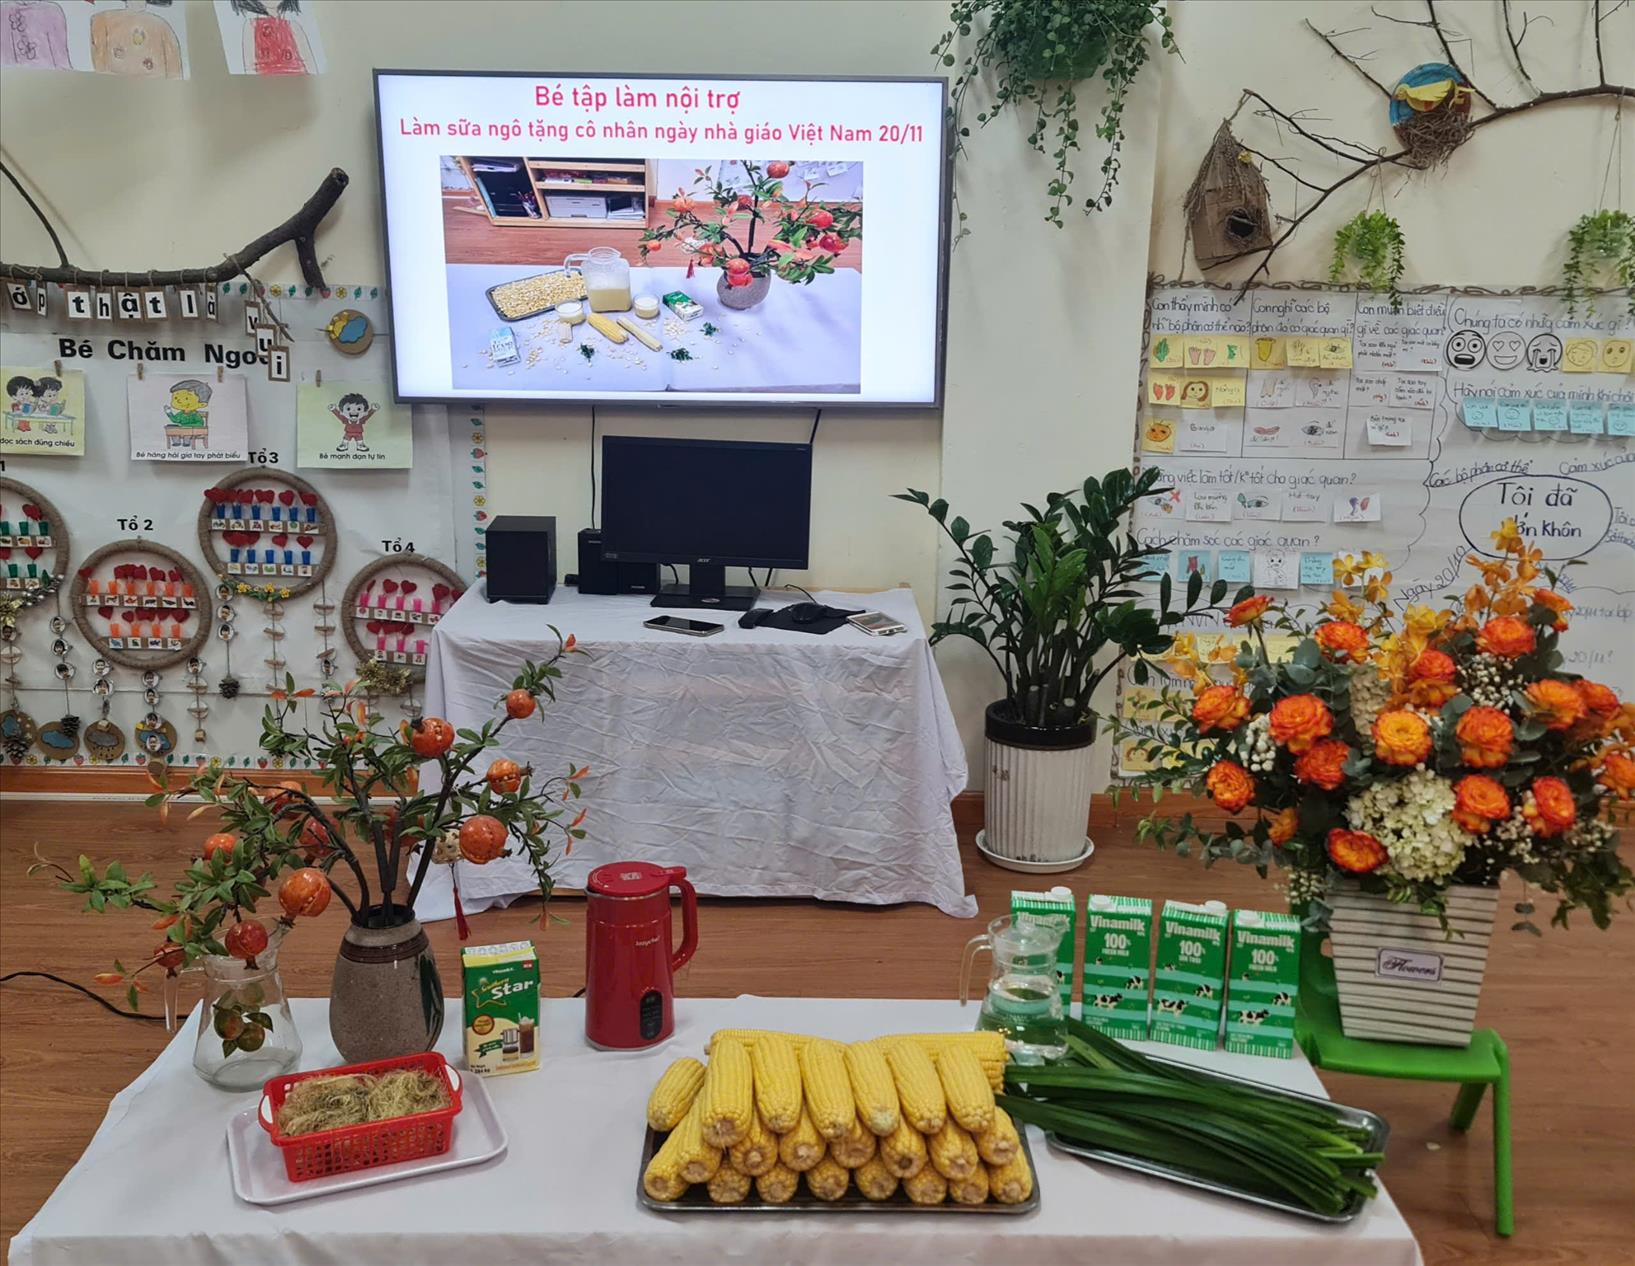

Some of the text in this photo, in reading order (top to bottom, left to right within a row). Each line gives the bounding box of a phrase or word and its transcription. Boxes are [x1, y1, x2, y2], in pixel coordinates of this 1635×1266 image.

[535, 83, 741, 114] Bé tập làm nội trợ
[400, 117, 923, 146] Làm sữa ngô tặng cô nhân ngày nhà giáo Việt Nam 20/11
[1194, 296, 1218, 312] mình
[1376, 303, 1405, 316] mun
[1454, 307, 1491, 335] Chúng
[1494, 314, 1506, 328] ta
[1508, 312, 1524, 328] có
[58, 338, 269, 369] Bé Chăm Ngo
[1267, 470, 1285, 484] cho
[1288, 469, 1316, 489] giác
[1498, 482, 1578, 507] Tôi đã
[116, 516, 154, 532] Tổ 2
[1247, 530, 1272, 550] giác
[1089, 915, 1145, 931] Vinamilk
[1165, 921, 1220, 942] Vinamilk
[1237, 930, 1295, 949] Vinamilk
[1382, 956, 1437, 975] Flowers
[491, 980, 534, 1000] Star
